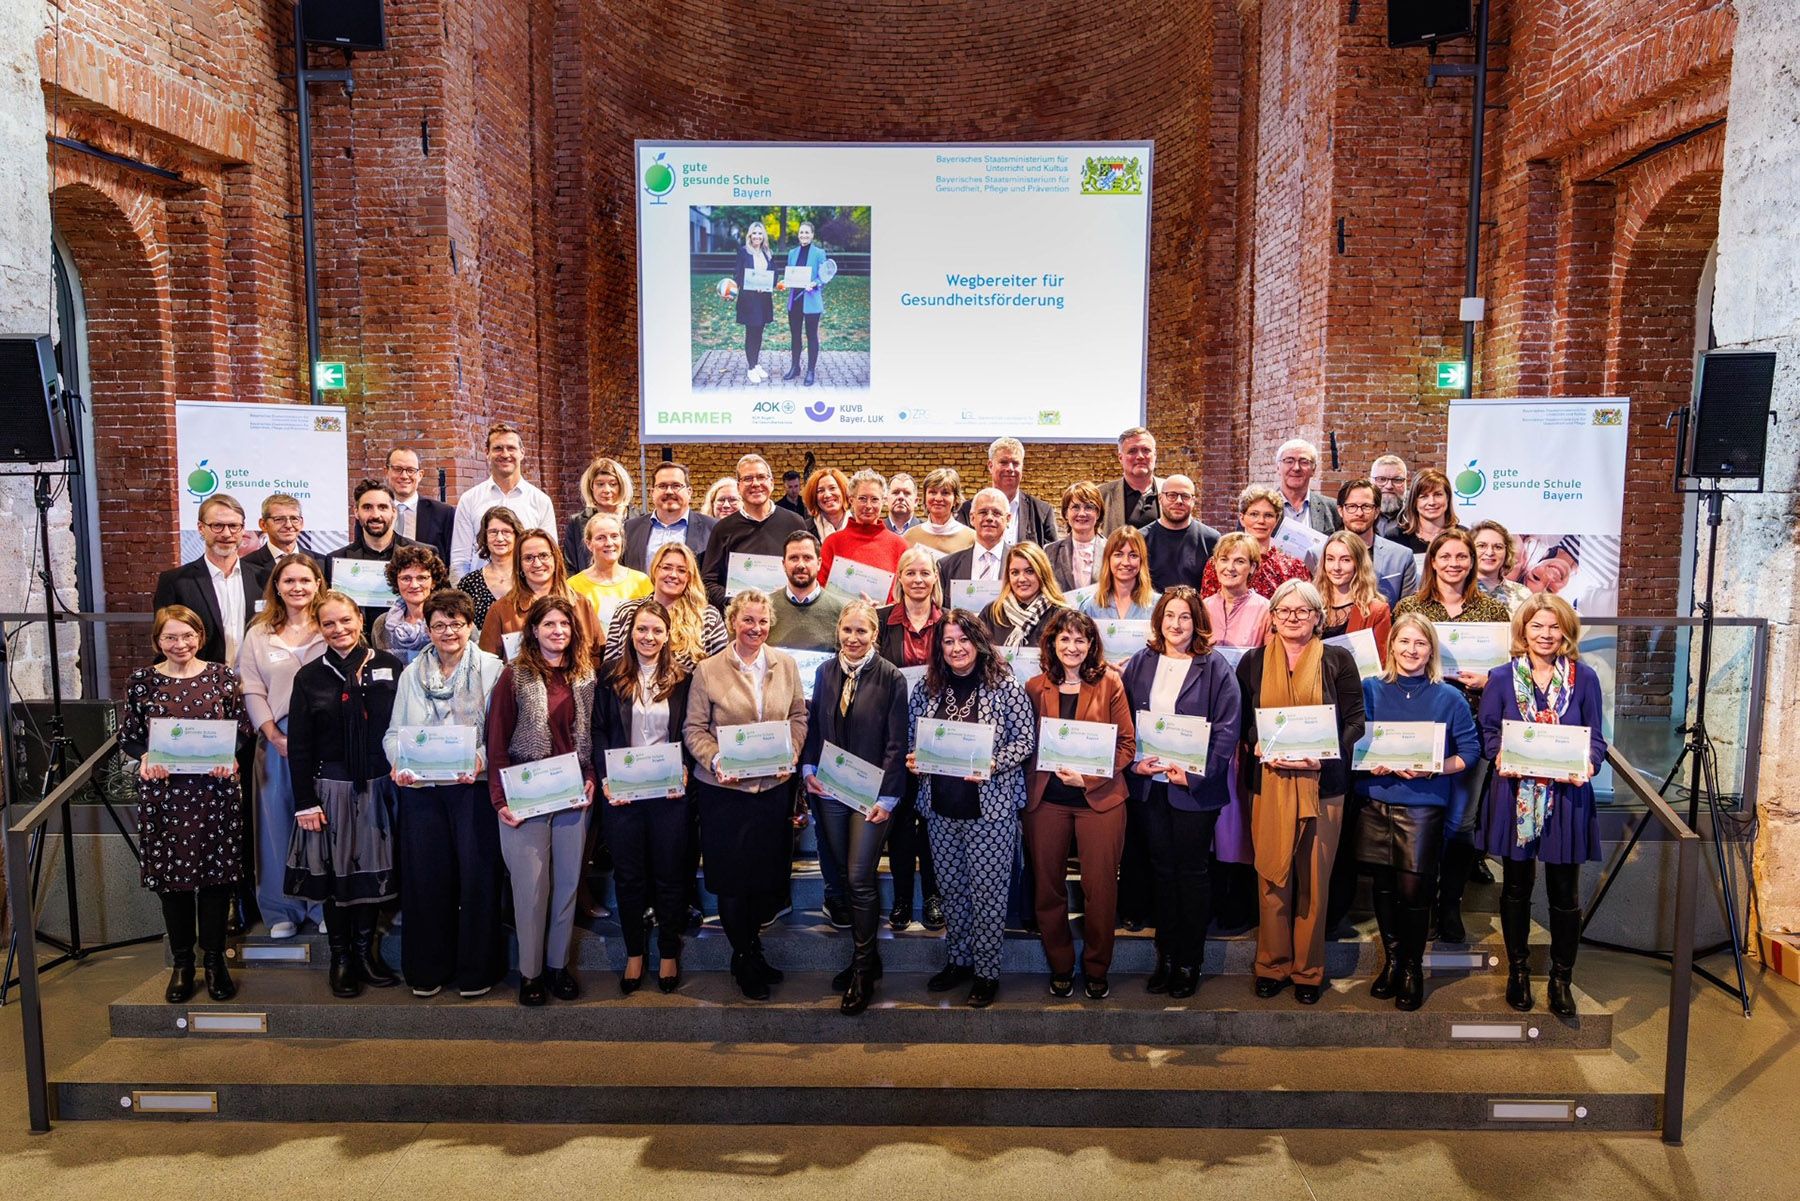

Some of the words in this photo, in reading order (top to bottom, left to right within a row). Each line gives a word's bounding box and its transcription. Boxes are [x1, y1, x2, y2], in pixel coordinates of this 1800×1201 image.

[936, 155, 982, 164] Bayerisches
[984, 155, 1055, 163] Staatsministerium
[1056, 155, 1069, 163] für
[682, 162, 708, 175] gute
[682, 175, 730, 187] gesunde
[733, 175, 770, 185] Schule
[935, 175, 982, 184] Bayerisches
[984, 175, 1057, 183] Staatsministerium
[733, 188, 772, 199] Bayern
[984, 185, 1009, 193] Pflege
[946, 274, 1037, 290] Wegbereiter
[1043, 274, 1064, 287] für
[901, 293, 1064, 310] Gesundheitsförderung
[752, 401, 780, 413] AOK
[840, 404, 863, 413] KUVB
[657, 411, 732, 424] BARMER
[840, 414, 866, 424] Bayer.
[867, 414, 884, 423] LUK
[225, 468, 250, 479] gute
[1493, 469, 1518, 478] gute
[225, 479, 271, 489] gesunde
[273, 479, 309, 488] Schule
[1492, 479, 1541, 490] gesunde
[1544, 479, 1582, 489] Schule
[1543, 490, 1583, 502] Bayern
